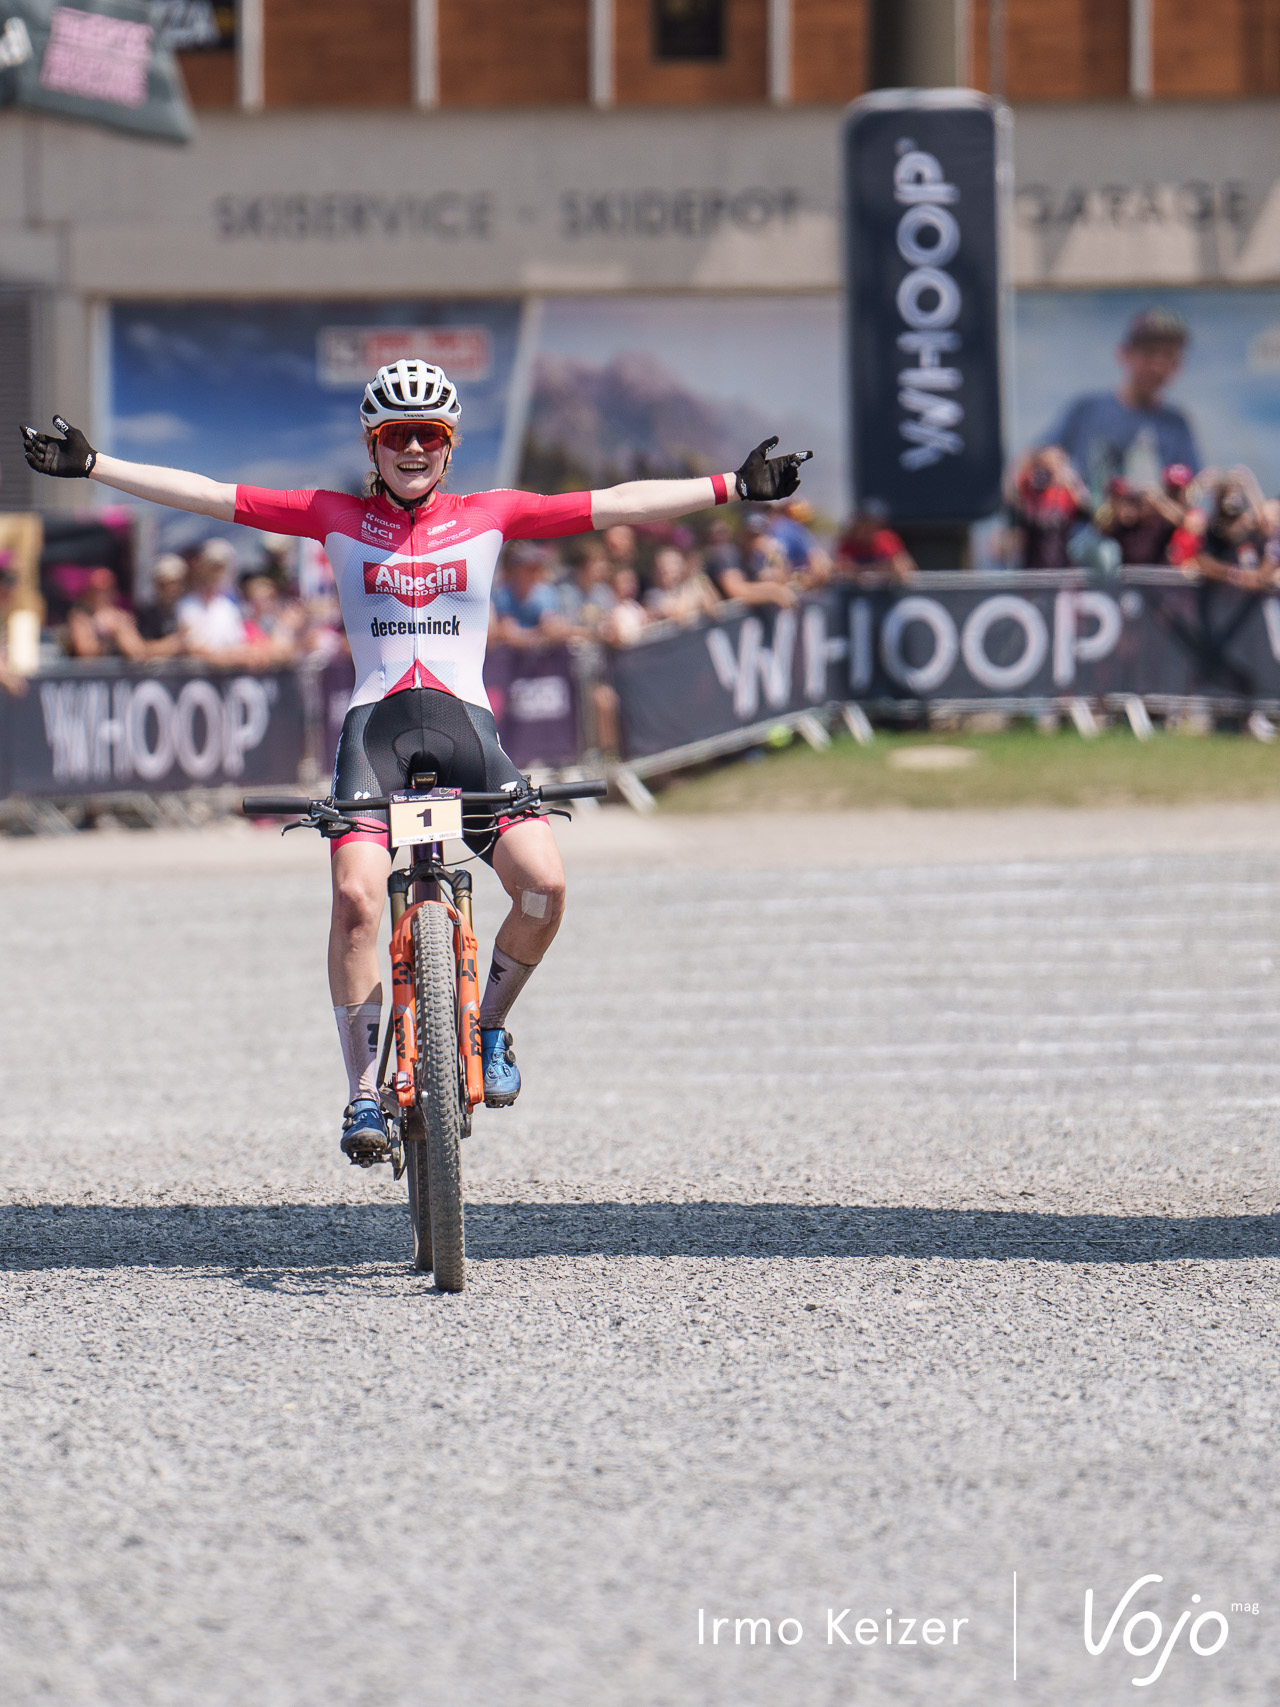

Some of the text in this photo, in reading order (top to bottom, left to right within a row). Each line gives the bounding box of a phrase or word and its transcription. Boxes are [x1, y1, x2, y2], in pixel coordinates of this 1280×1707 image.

[215, 192, 496, 241] SKISERVICE
[560, 186, 802, 238] SKIDEPOT
[893, 150, 964, 471] WHOOP
[367, 524, 393, 540] UCI
[375, 565, 457, 595] Alpecin
[370, 615, 460, 638] deceuninck
[705, 589, 1122, 718] WHOOP
[39, 676, 270, 785] WHOOP
[416, 808, 433, 828] 1
